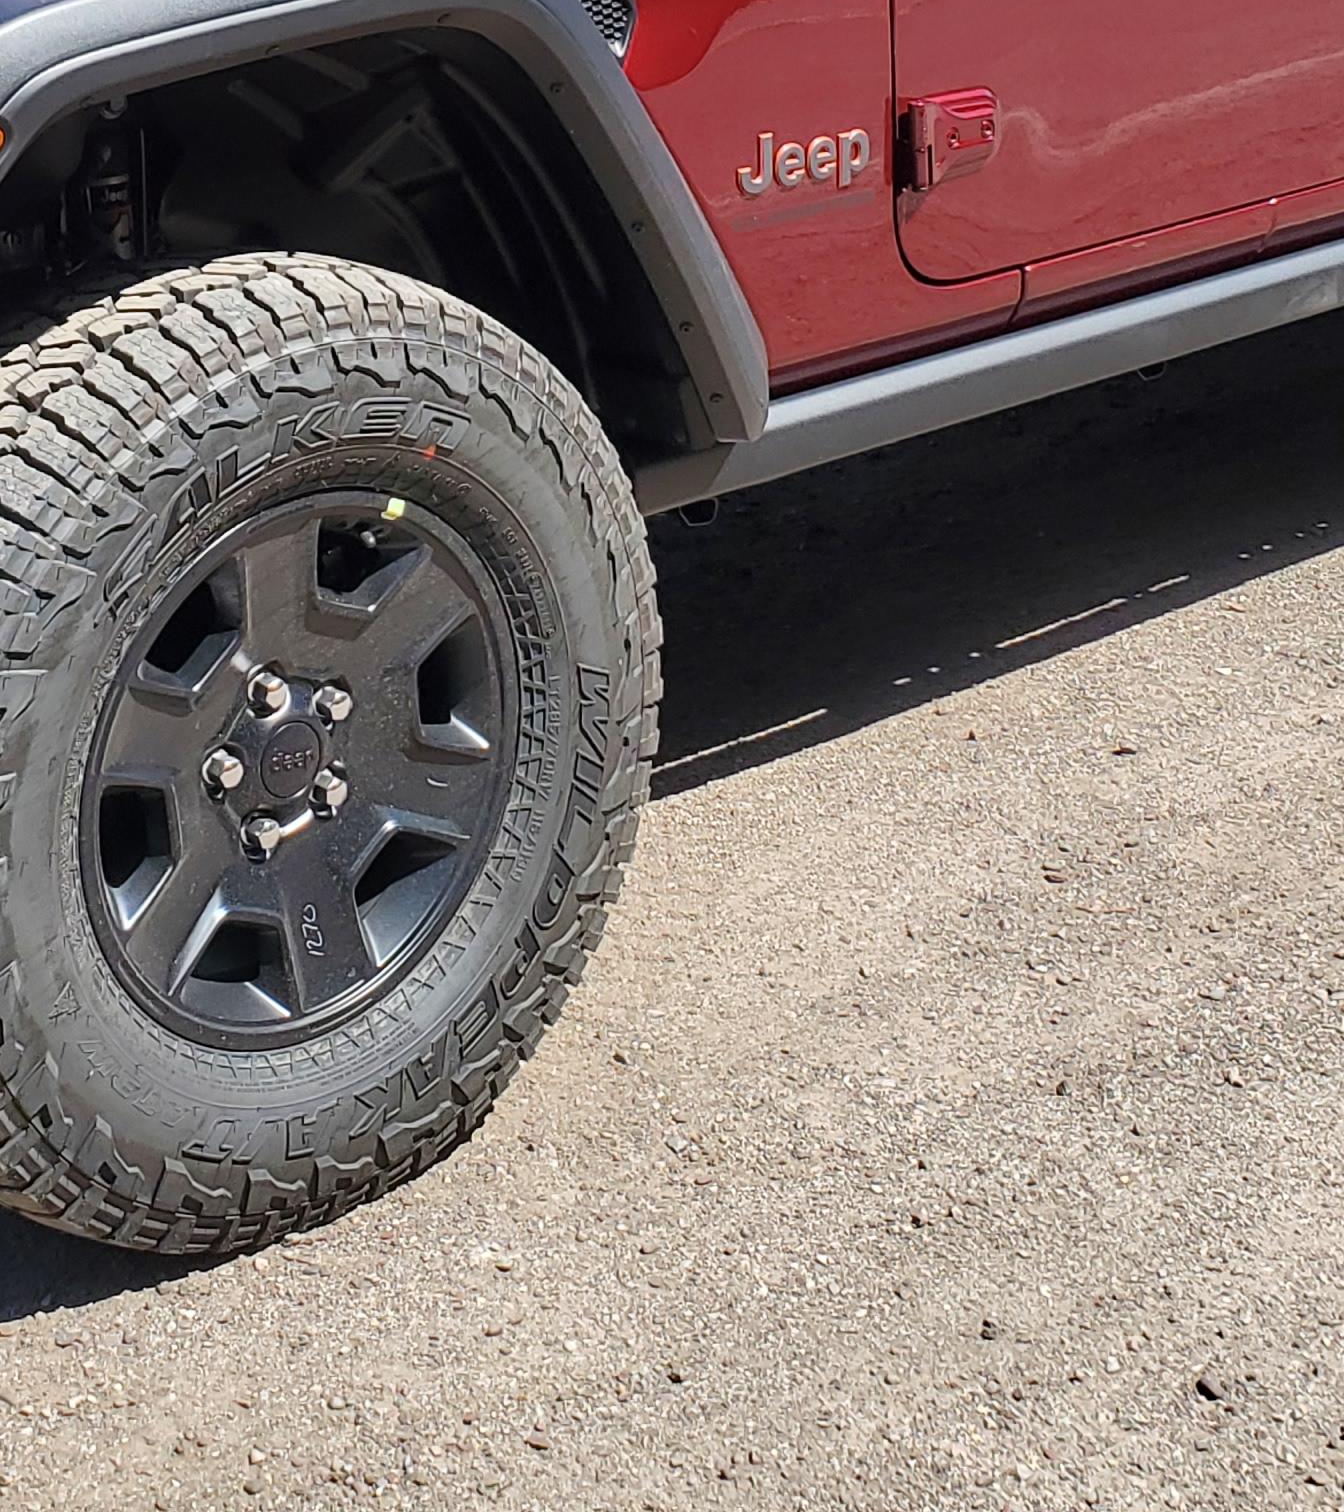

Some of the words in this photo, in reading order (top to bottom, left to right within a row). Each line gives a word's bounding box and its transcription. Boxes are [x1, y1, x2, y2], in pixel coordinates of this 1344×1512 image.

[737, 126, 871, 195] Jeep
[93, 395, 473, 629] FALKEN
[301, 903, 326, 957] 1270
